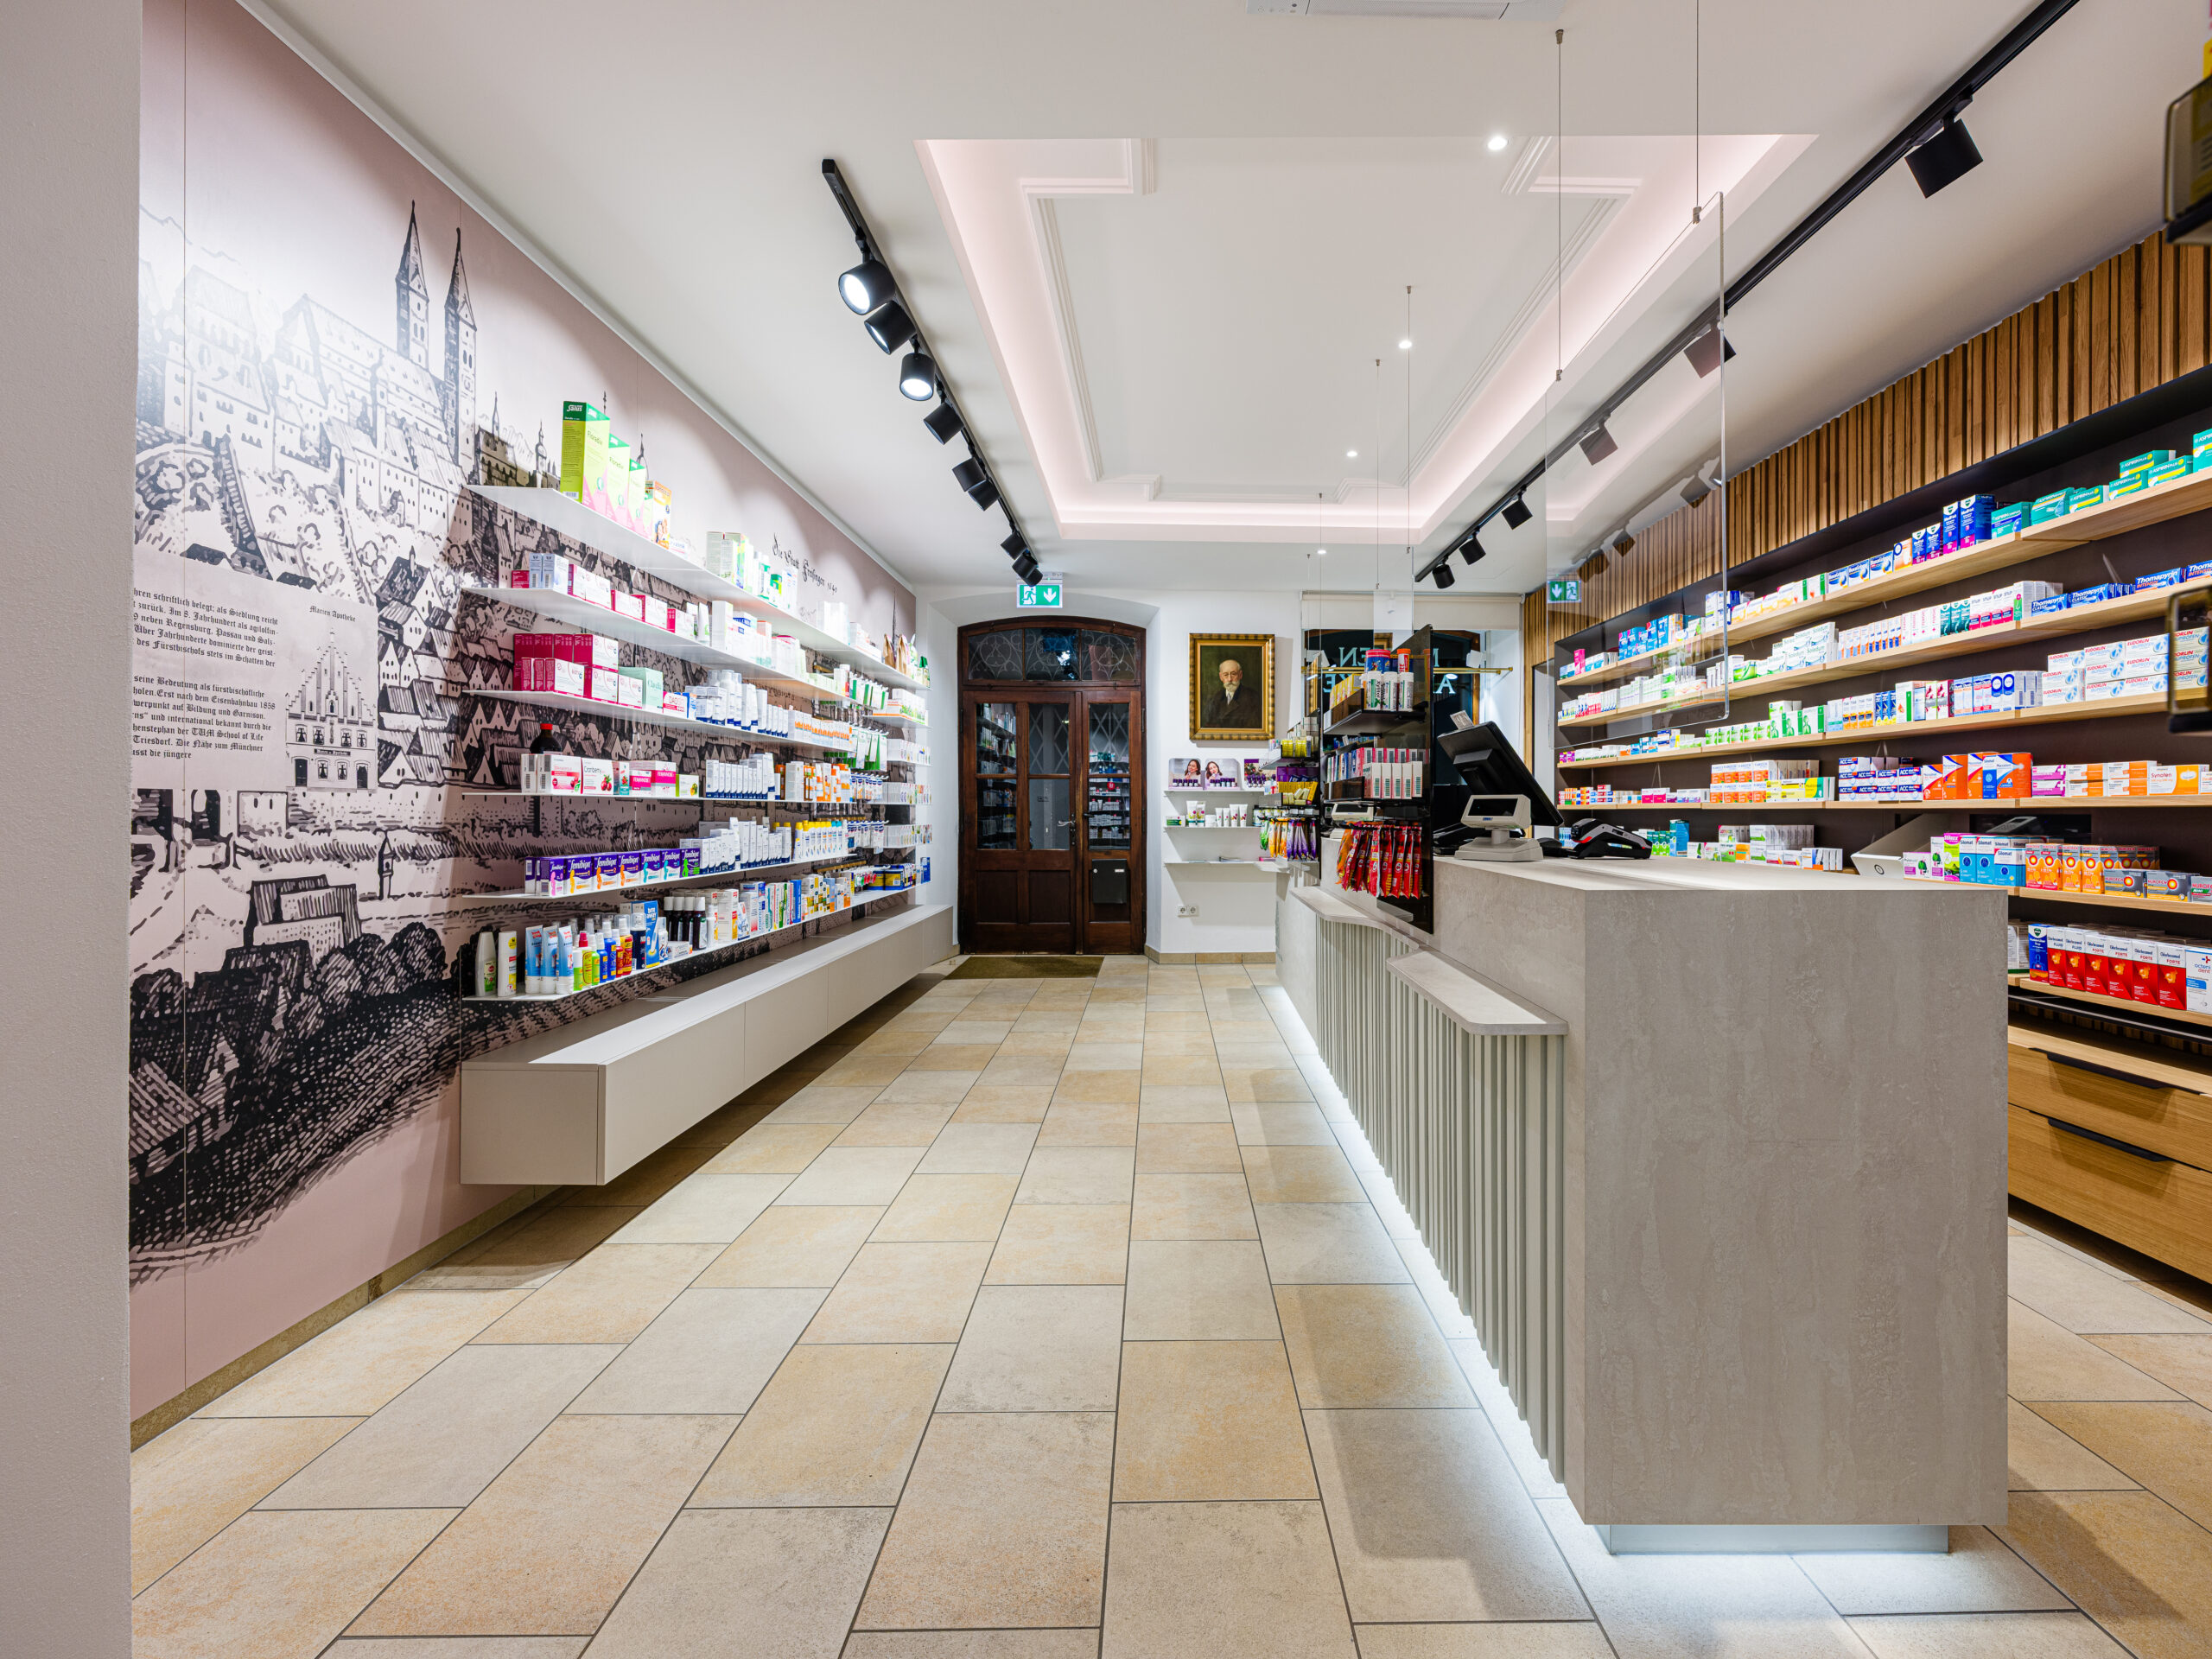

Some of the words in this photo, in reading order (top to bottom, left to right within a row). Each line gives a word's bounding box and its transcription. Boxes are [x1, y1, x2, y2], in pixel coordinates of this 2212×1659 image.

[2137, 570, 2178, 585] Thomapyrin
[2032, 595, 2066, 607] Thomapyrin
[2072, 587, 2107, 600] Thomapyrin
[153, 594, 190, 607] schriftlich
[229, 608, 259, 622] Siedlung
[141, 615, 163, 625] neben
[216, 627, 242, 639] Passau
[193, 612, 236, 627] Jahrhundert
[137, 638, 150, 647] des
[152, 640, 205, 656] Fürstbischofs
[207, 650, 223, 658] stets
[157, 628, 207, 645] Jahrhunderte
[209, 639, 245, 651] dominierte
[246, 645, 256, 653] der
[134, 676, 155, 684] seine
[156, 676, 198, 690] Bedeutung
[200, 683, 211, 691] als
[194, 693, 209, 702] dem
[211, 696, 257, 709] Eisenbahnbau
[260, 701, 276, 710] 1858
[186, 703, 216, 716] Bildung
[150, 713, 165, 721] und
[168, 715, 214, 726] international
[215, 719, 242, 728] bekannt
[243, 721, 261, 730] durch
[177, 727, 189, 735] der
[216, 729, 240, 740] School
[175, 738, 190, 747] Die
[230, 742, 264, 752] Münchner
[163, 749, 192, 760] jüngere
